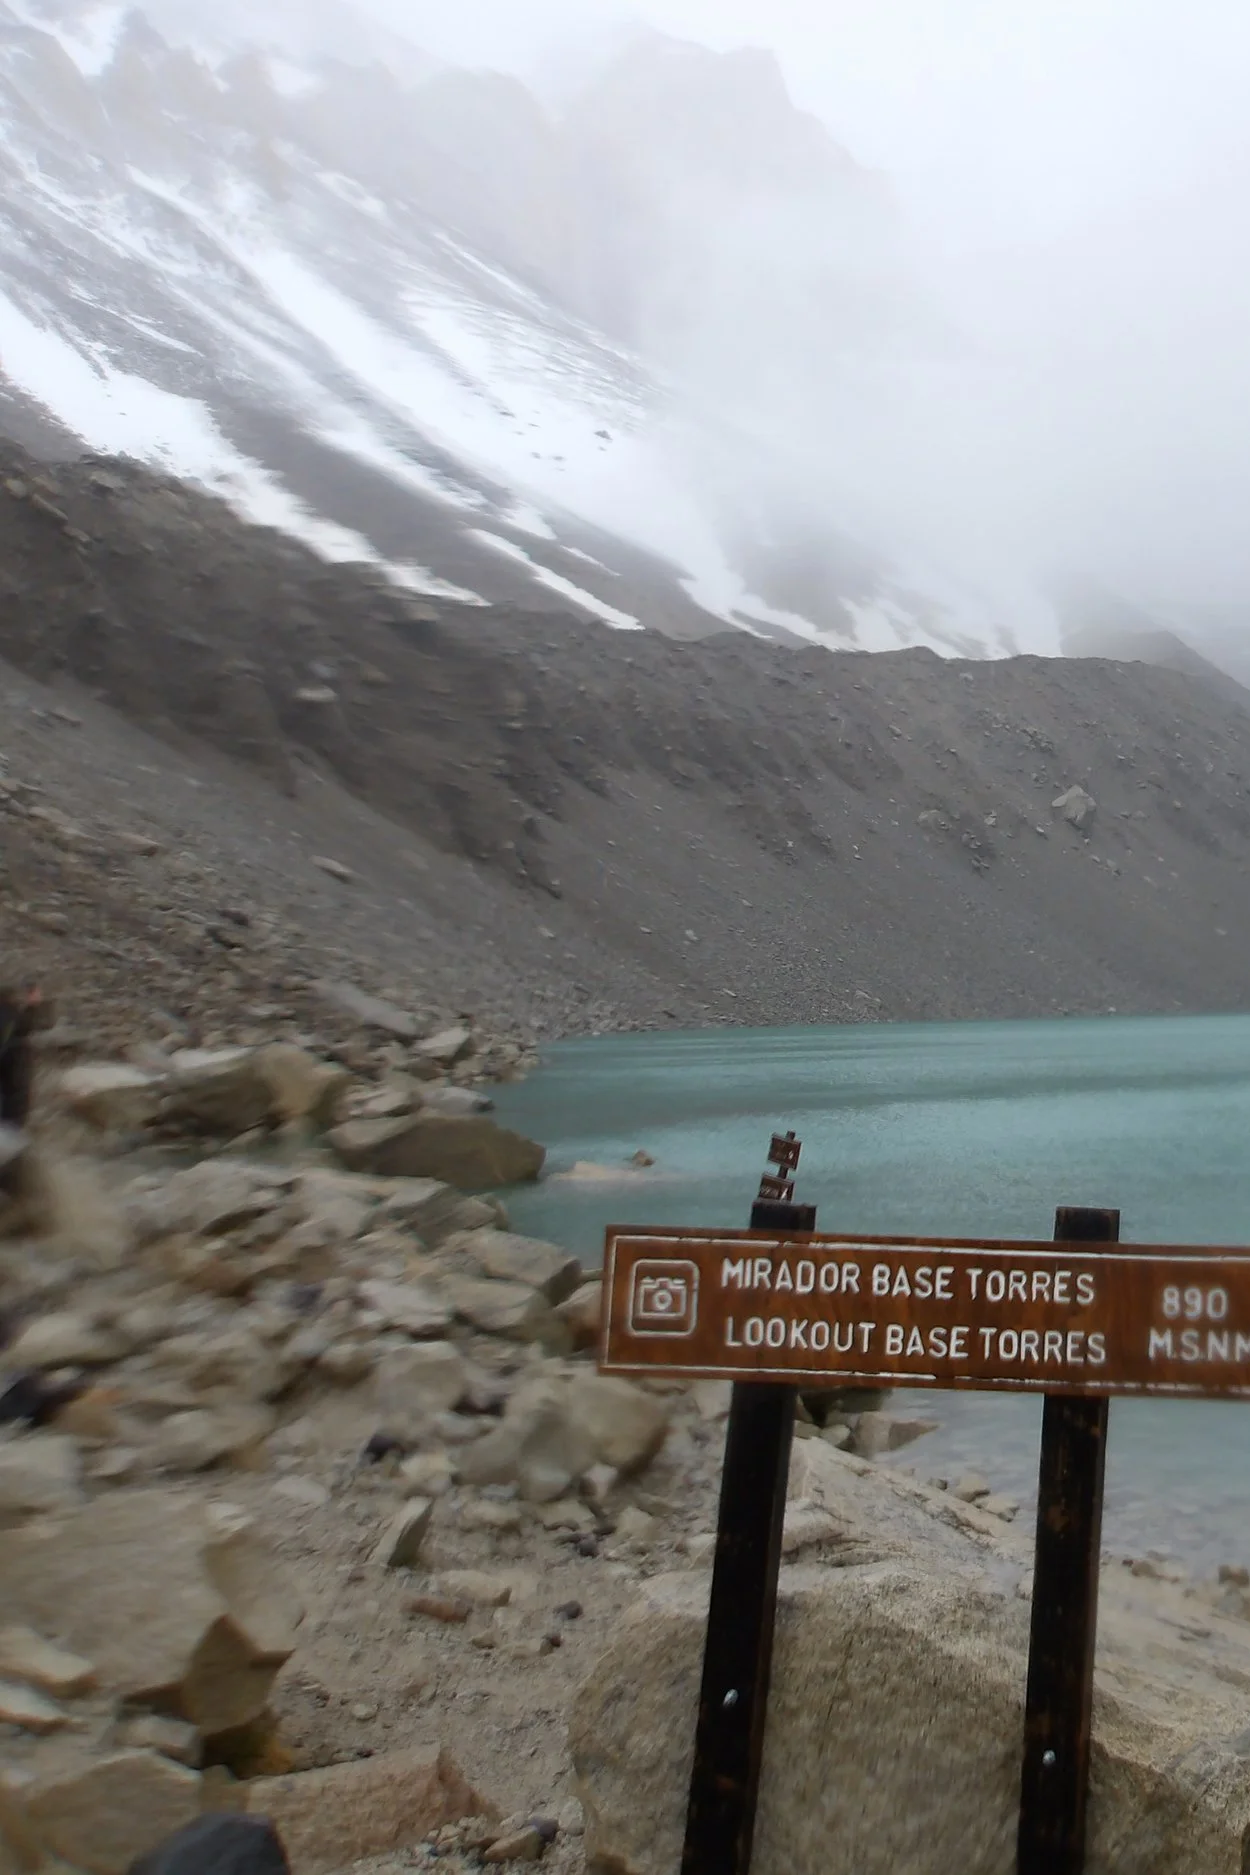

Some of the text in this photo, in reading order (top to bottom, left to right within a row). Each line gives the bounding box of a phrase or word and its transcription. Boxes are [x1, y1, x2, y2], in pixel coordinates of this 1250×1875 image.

[720, 1257, 1096, 1306] MIRADOR BASE TORRES
[1162, 1285, 1228, 1321] 890
[725, 1316, 1107, 1366] LOOKOUT BASE TORRES
